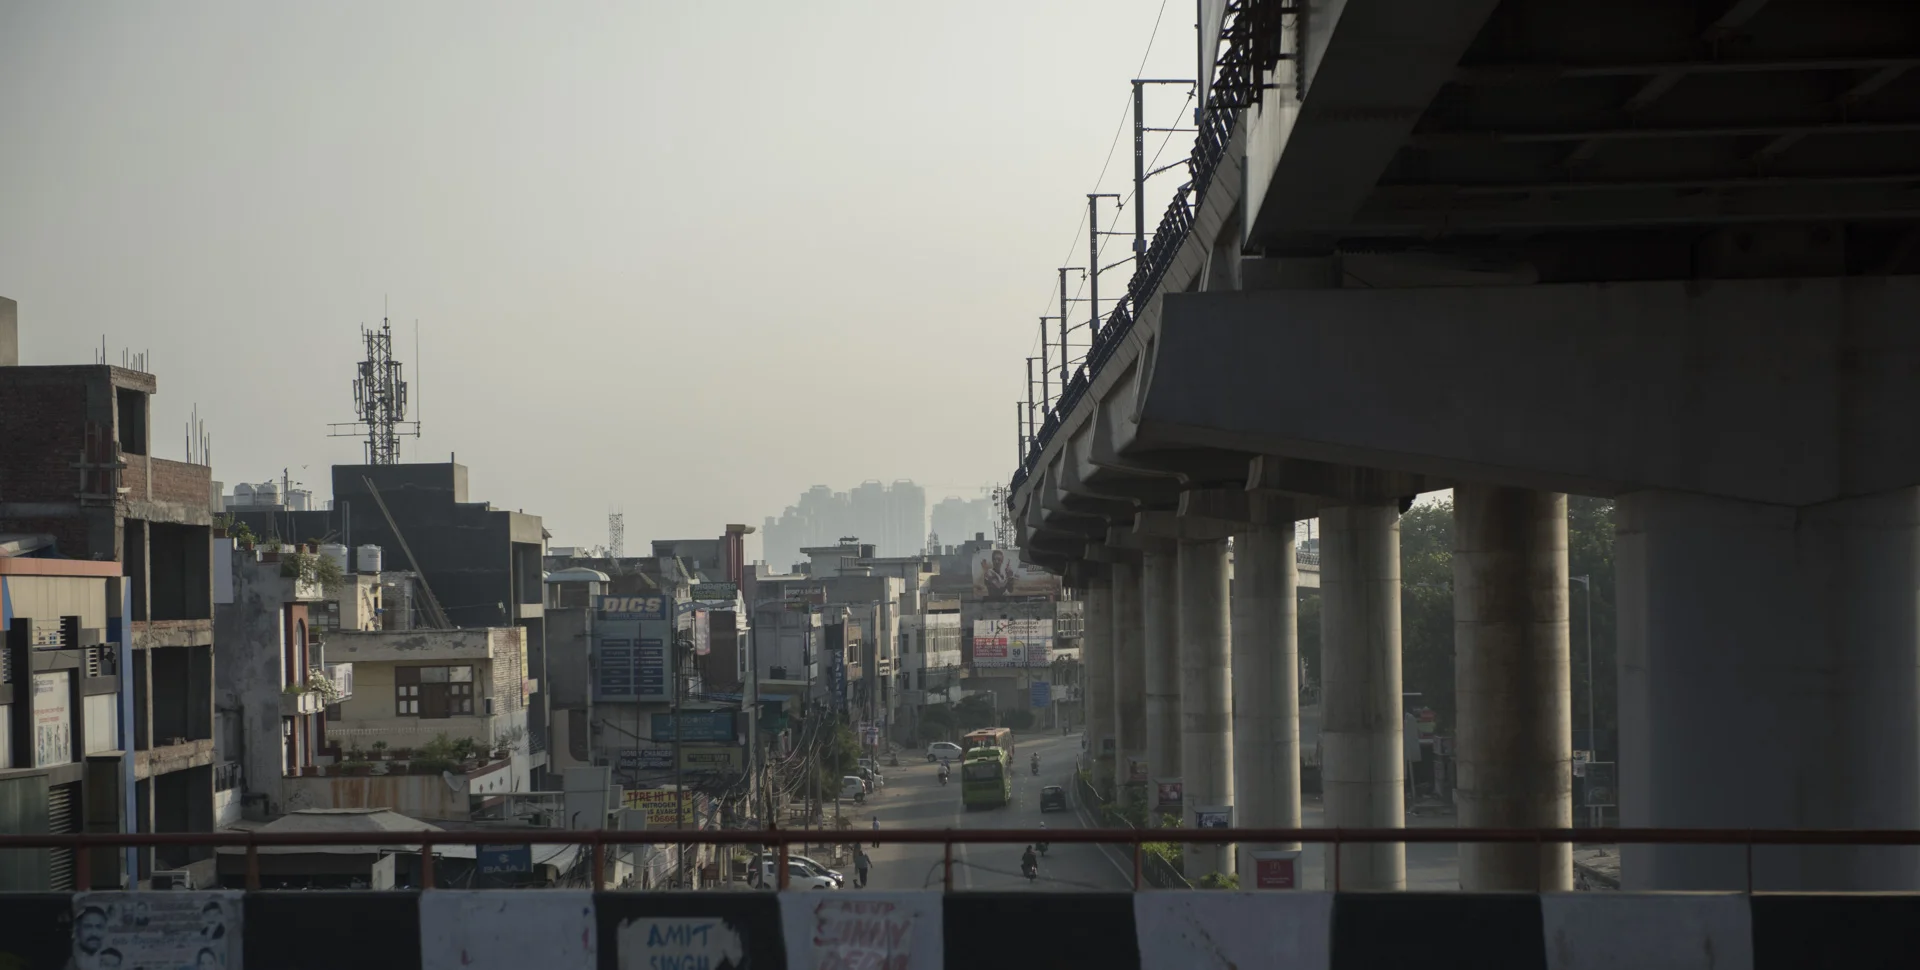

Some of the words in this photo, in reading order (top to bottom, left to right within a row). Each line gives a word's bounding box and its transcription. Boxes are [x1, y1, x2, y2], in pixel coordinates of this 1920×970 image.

[602, 597, 662, 612] DICS
[627, 792, 651, 802] TYRE
[654, 791, 664, 801] HI
[483, 861, 526, 873] BAJAJ
[646, 922, 716, 948] AMIT
